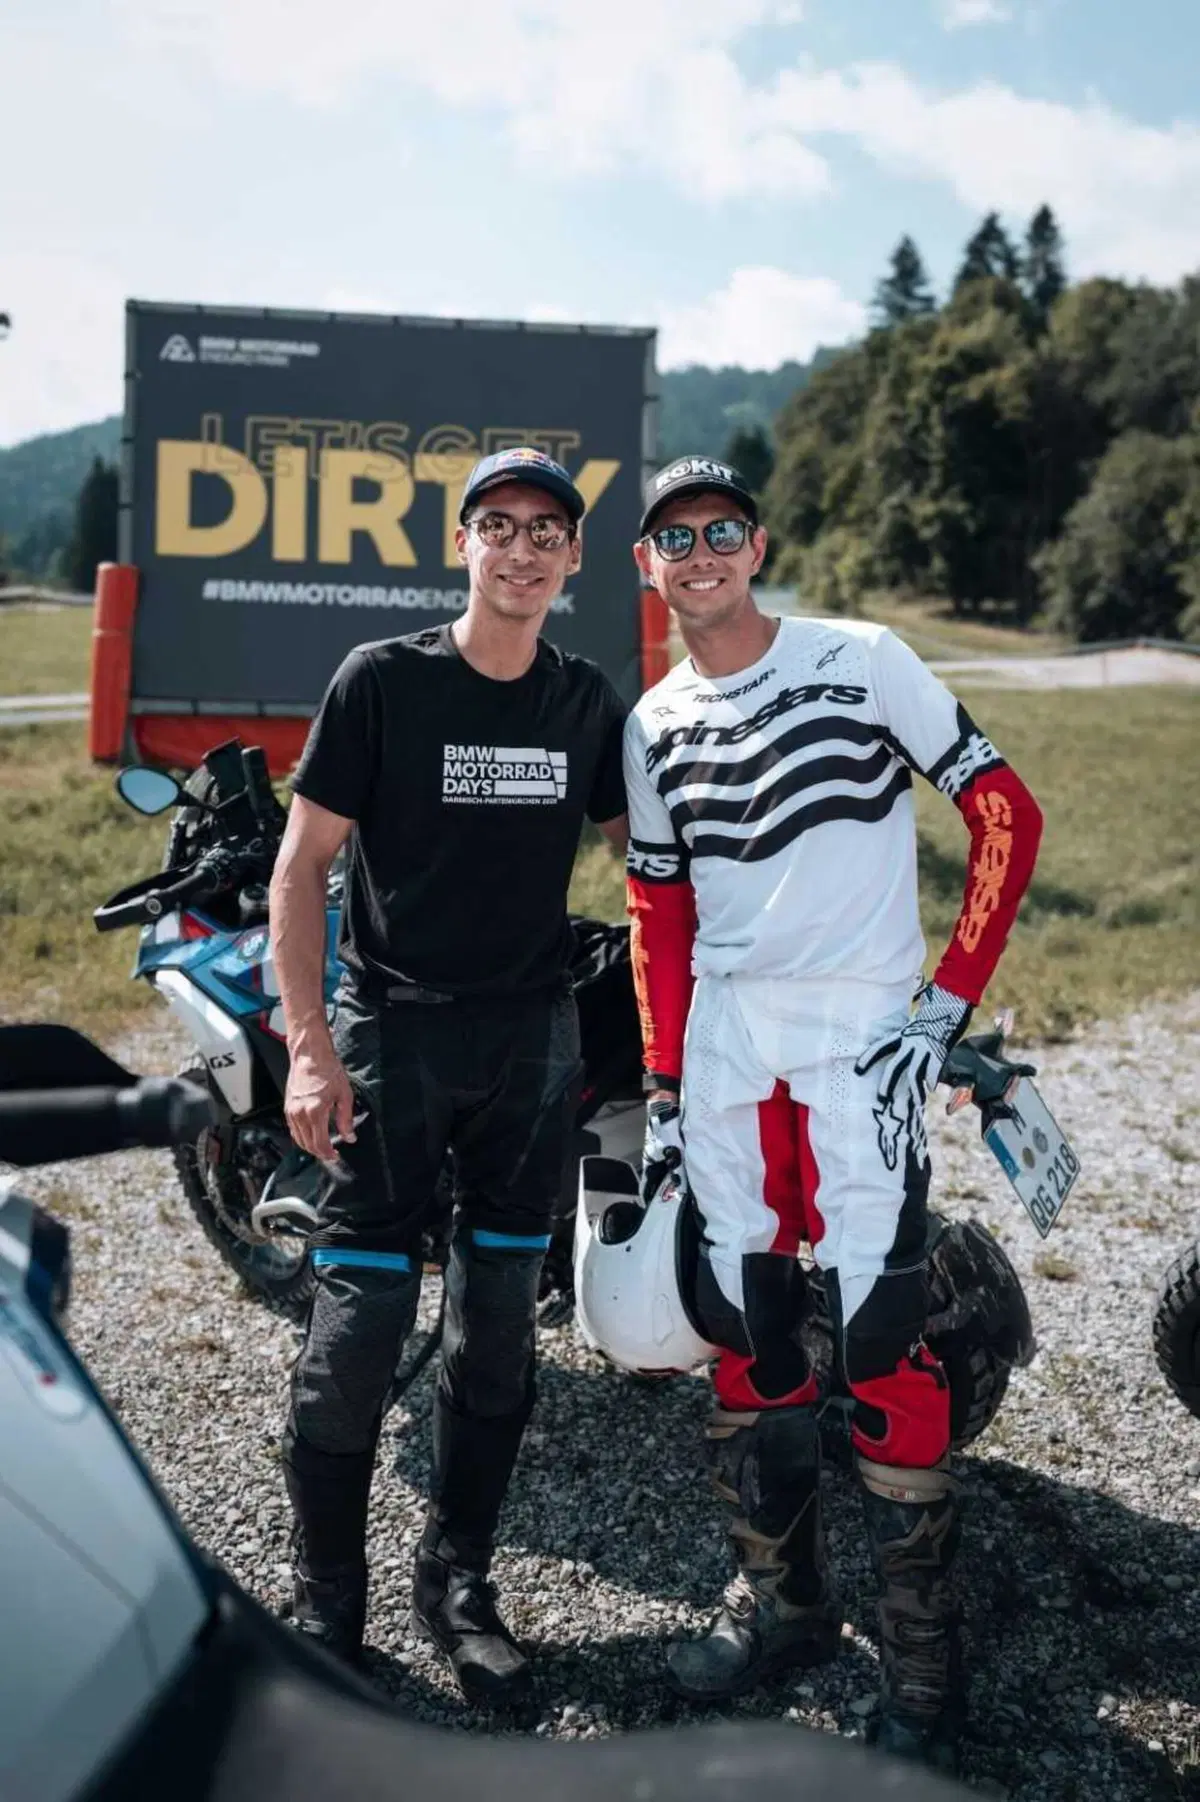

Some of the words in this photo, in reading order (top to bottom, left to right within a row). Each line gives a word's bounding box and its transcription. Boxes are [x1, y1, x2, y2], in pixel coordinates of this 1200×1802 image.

[656, 459, 733, 490] ROKIT
[443, 744, 494, 762] BMW
[443, 761, 552, 779] MOTORRAD
[442, 778, 494, 796] DAYS
[209, 1052, 236, 1069] GS
[1046, 1143, 1077, 1196] 218
